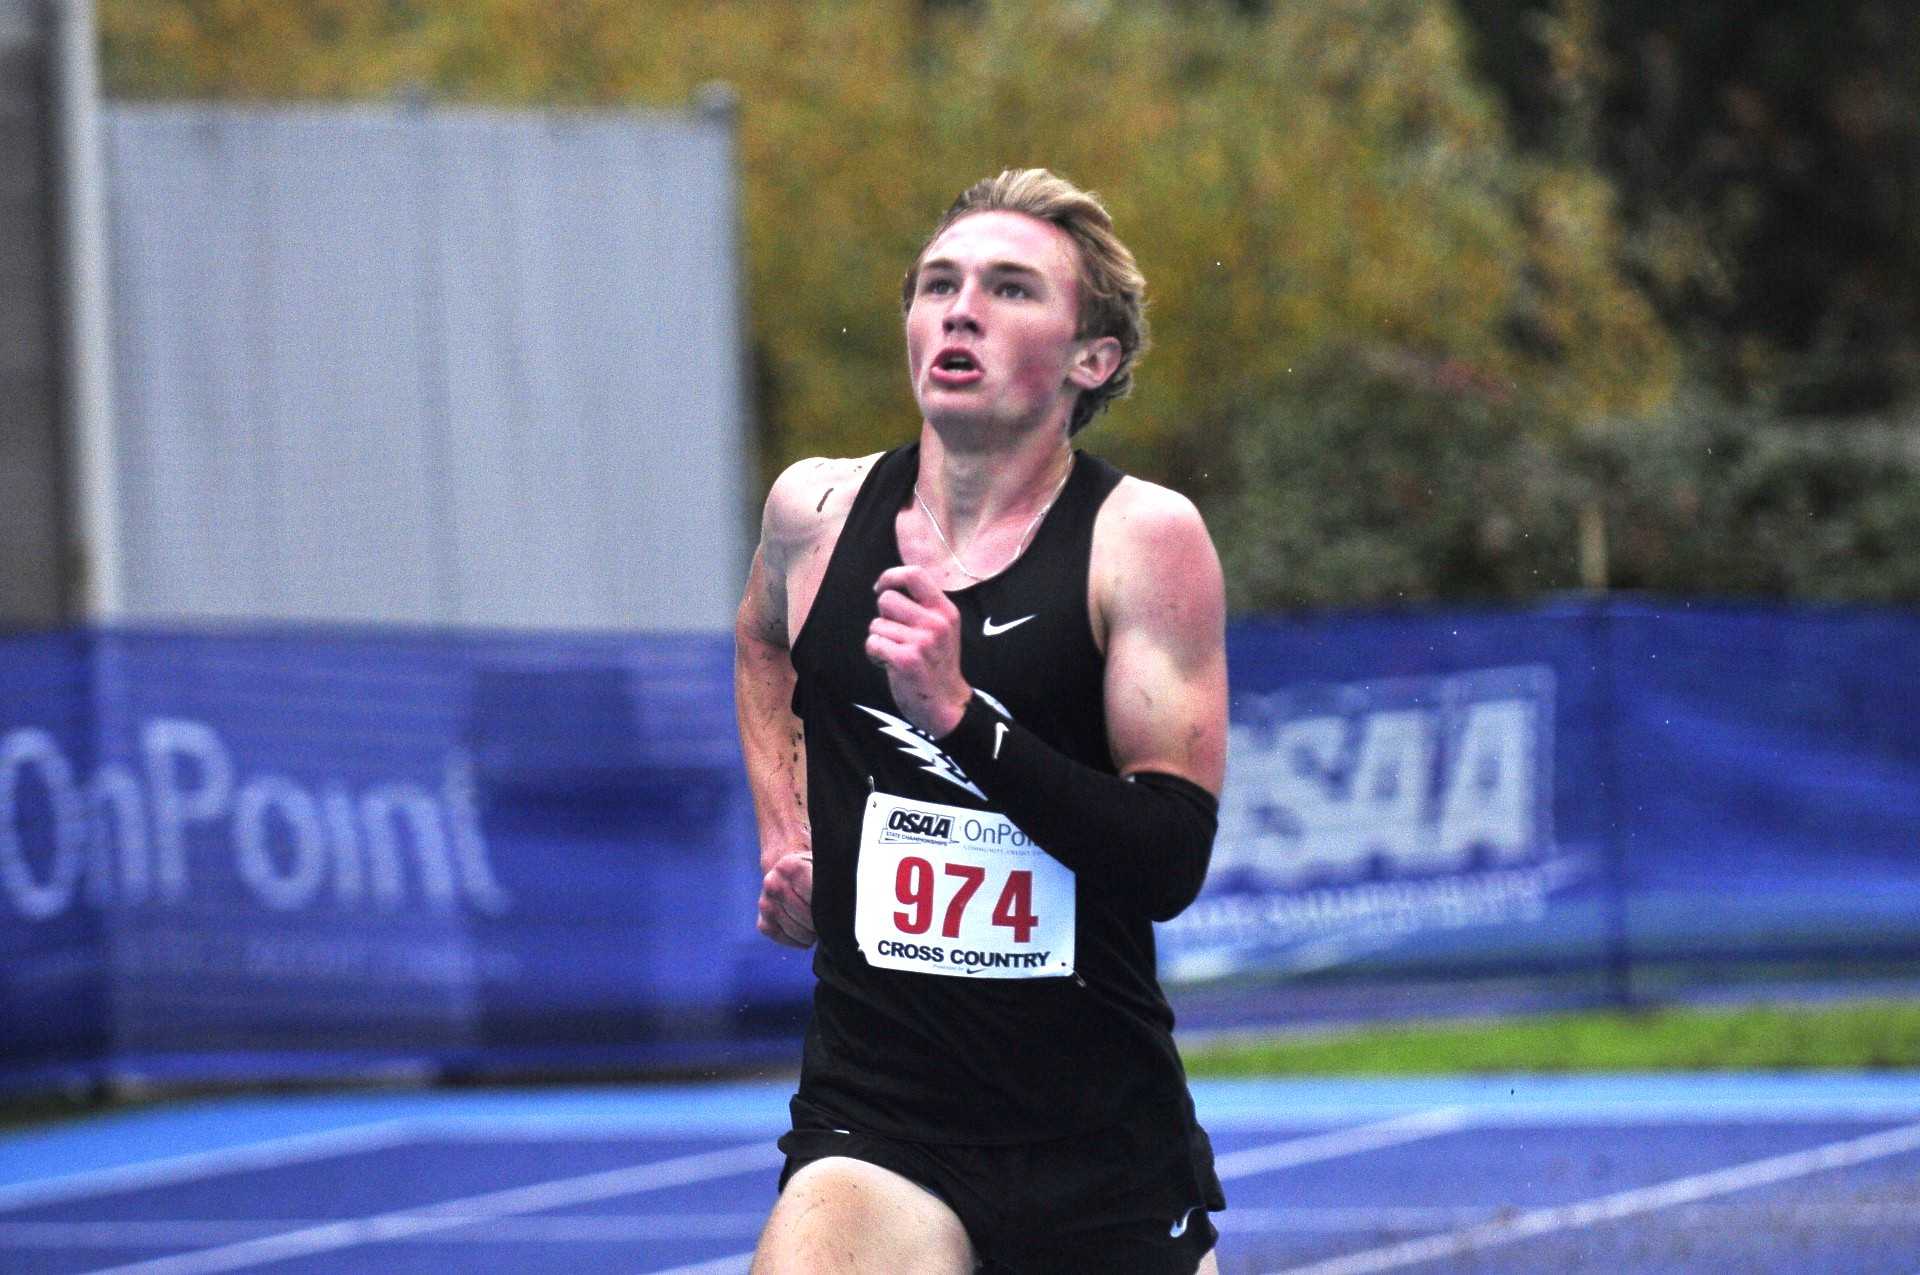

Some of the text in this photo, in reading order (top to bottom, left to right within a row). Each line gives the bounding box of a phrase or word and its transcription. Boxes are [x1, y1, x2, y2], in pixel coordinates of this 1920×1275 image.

[888, 810, 952, 839] OSAA
[964, 819, 1041, 847] OnPo
[893, 856, 1039, 943] 974
[877, 940, 1051, 969] CROSS COUNTRY
